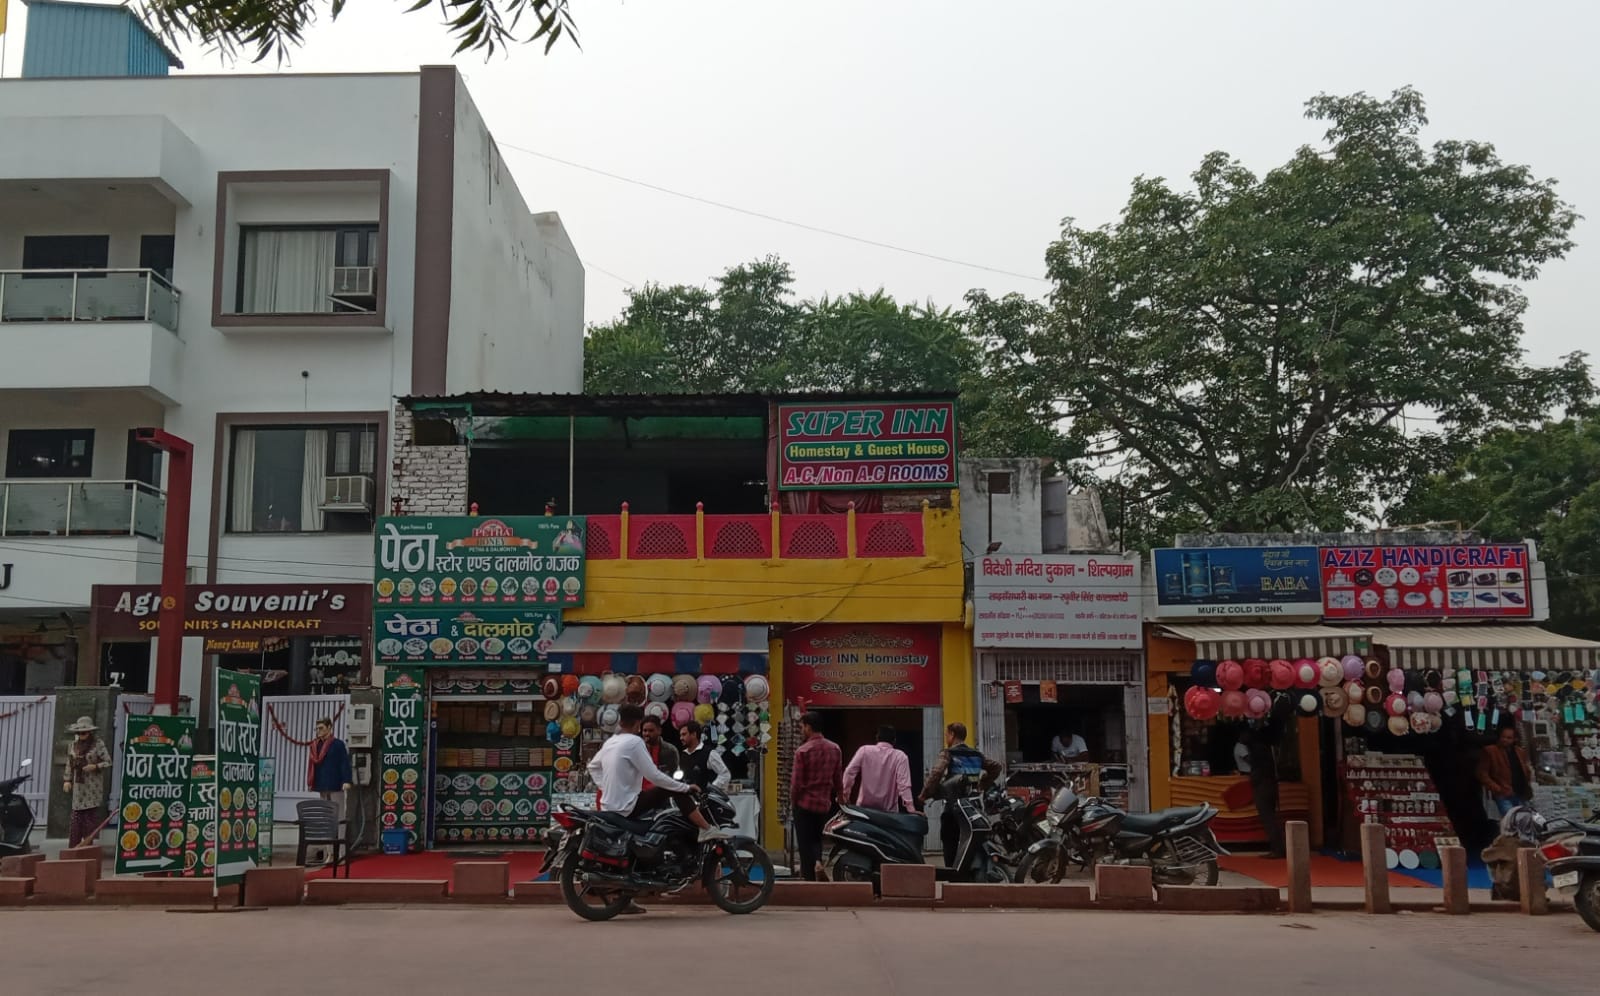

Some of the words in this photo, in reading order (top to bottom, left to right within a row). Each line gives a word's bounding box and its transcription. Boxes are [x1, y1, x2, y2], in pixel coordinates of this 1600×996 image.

[787, 411, 884, 437] SUPER
[892, 409, 948, 434] INN
[790, 445, 850, 459] Homestay
[854, 444, 863, 456] &
[868, 443, 903, 456] Guest
[907, 443, 945, 455] House
[888, 464, 948, 482] ROOMS
[379, 523, 439, 573] पेठा
[1324, 549, 1376, 567] AZIZ
[1382, 548, 1525, 567] HANDICRAFT
[435, 552, 464, 573] स्टोर
[467, 555, 491, 572] एण्ड
[494, 552, 544, 572] दालमोठ
[546, 555, 581, 572] गजक
[983, 558, 1012, 576] विदेशी
[1015, 558, 1043, 576] मदिरा
[1046, 563, 1075, 583] दुकान
[1088, 559, 1134, 579] शिल्पग्राम
[1260, 576, 1309, 591] BABA
[114, 591, 161, 616] Agr
[194, 589, 345, 612] Souvenir's
[1197, 606, 1225, 614] MUFIZ
[1254, 605, 1284, 613] DRINK
[139, 619, 219, 630] SONIR'S
[231, 619, 321, 629] HANDICRAFT
[384, 613, 440, 636] पेठा
[451, 625, 459, 637] &
[463, 618, 535, 637] दालमोठ
[205, 640, 231, 651] Money
[232, 639, 259, 651] Change
[794, 653, 832, 667] Super
[837, 653, 859, 664] INN
[865, 652, 928, 667] Homestay
[389, 693, 417, 718] पेठा
[219, 711, 237, 752] पेठा
[238, 714, 259, 756] स्टोर
[384, 721, 419, 748] स्टोर
[126, 747, 154, 778] पेठा
[157, 748, 190, 779] स्टोर
[384, 750, 419, 765] दालमोठ
[222, 757, 256, 781] दालमोठ
[129, 781, 184, 800] दालमोठ
